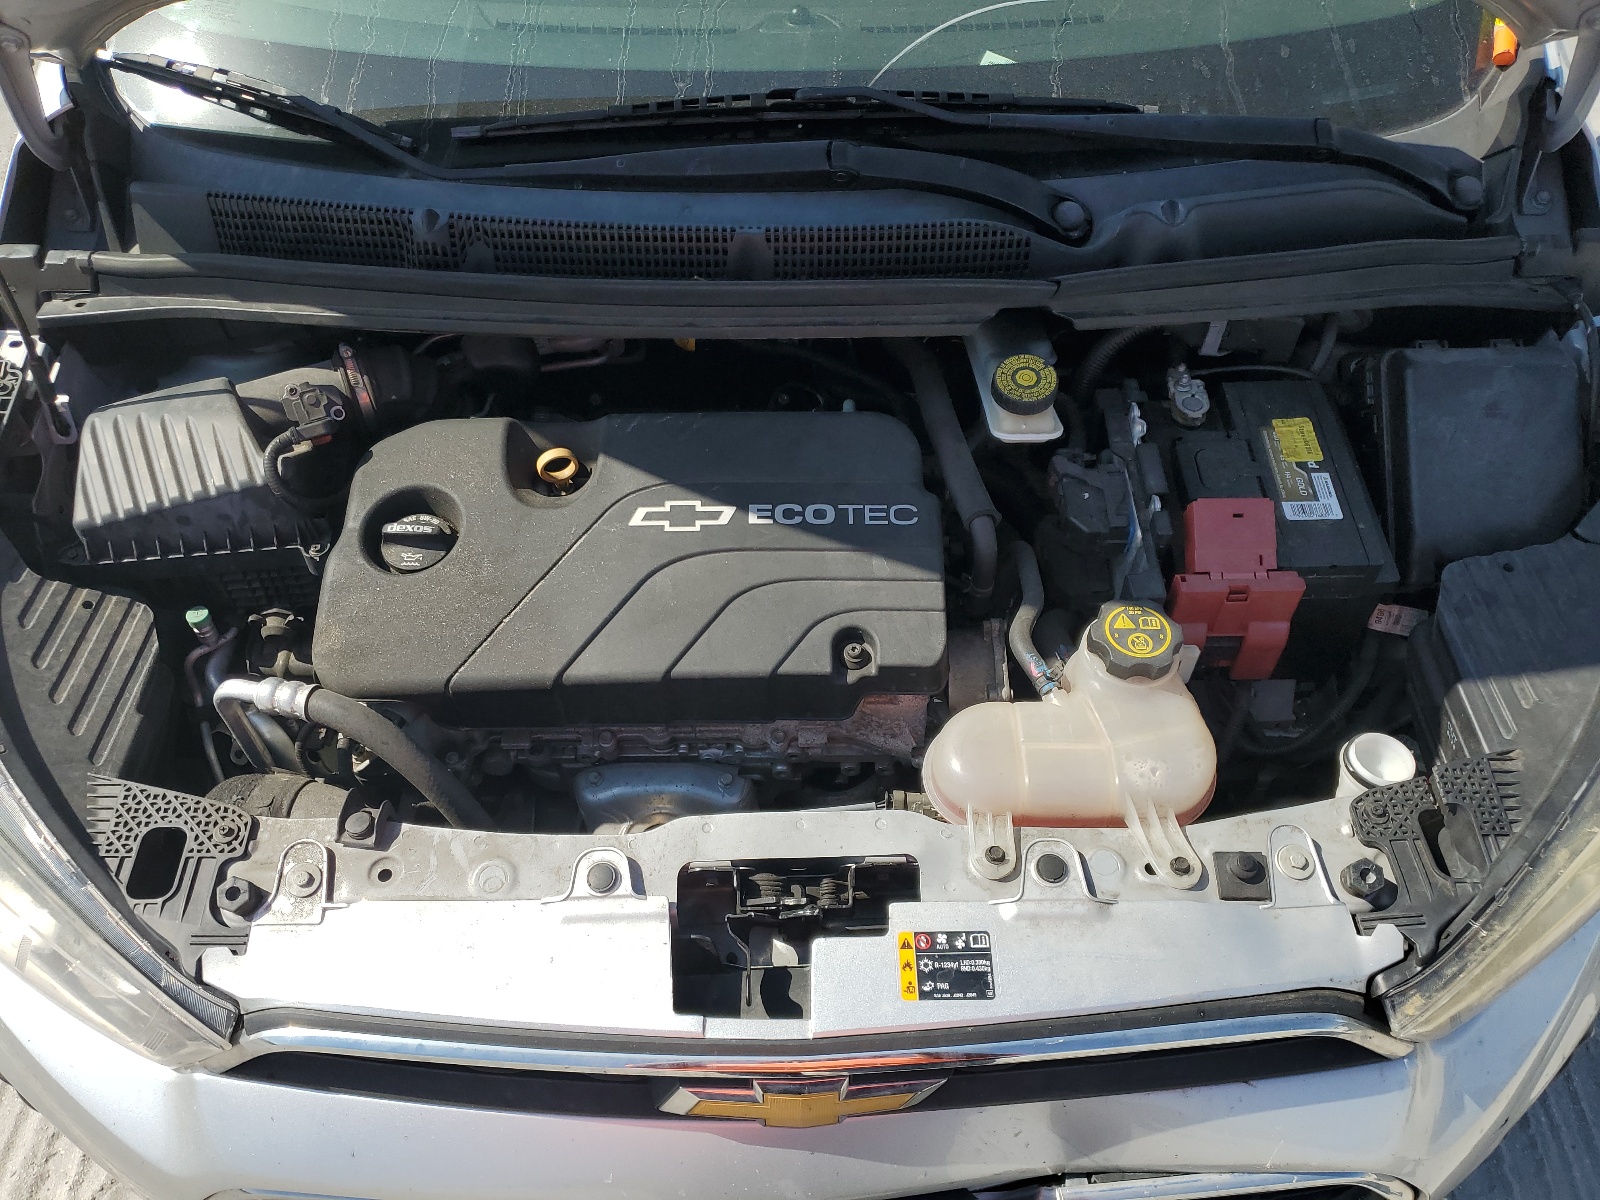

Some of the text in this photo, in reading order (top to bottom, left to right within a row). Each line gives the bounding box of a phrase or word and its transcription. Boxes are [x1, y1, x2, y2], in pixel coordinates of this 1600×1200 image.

[1296, 477, 1308, 496] GOLD
[748, 503, 919, 526] ECOTEC
[387, 523, 435, 533] dexos
